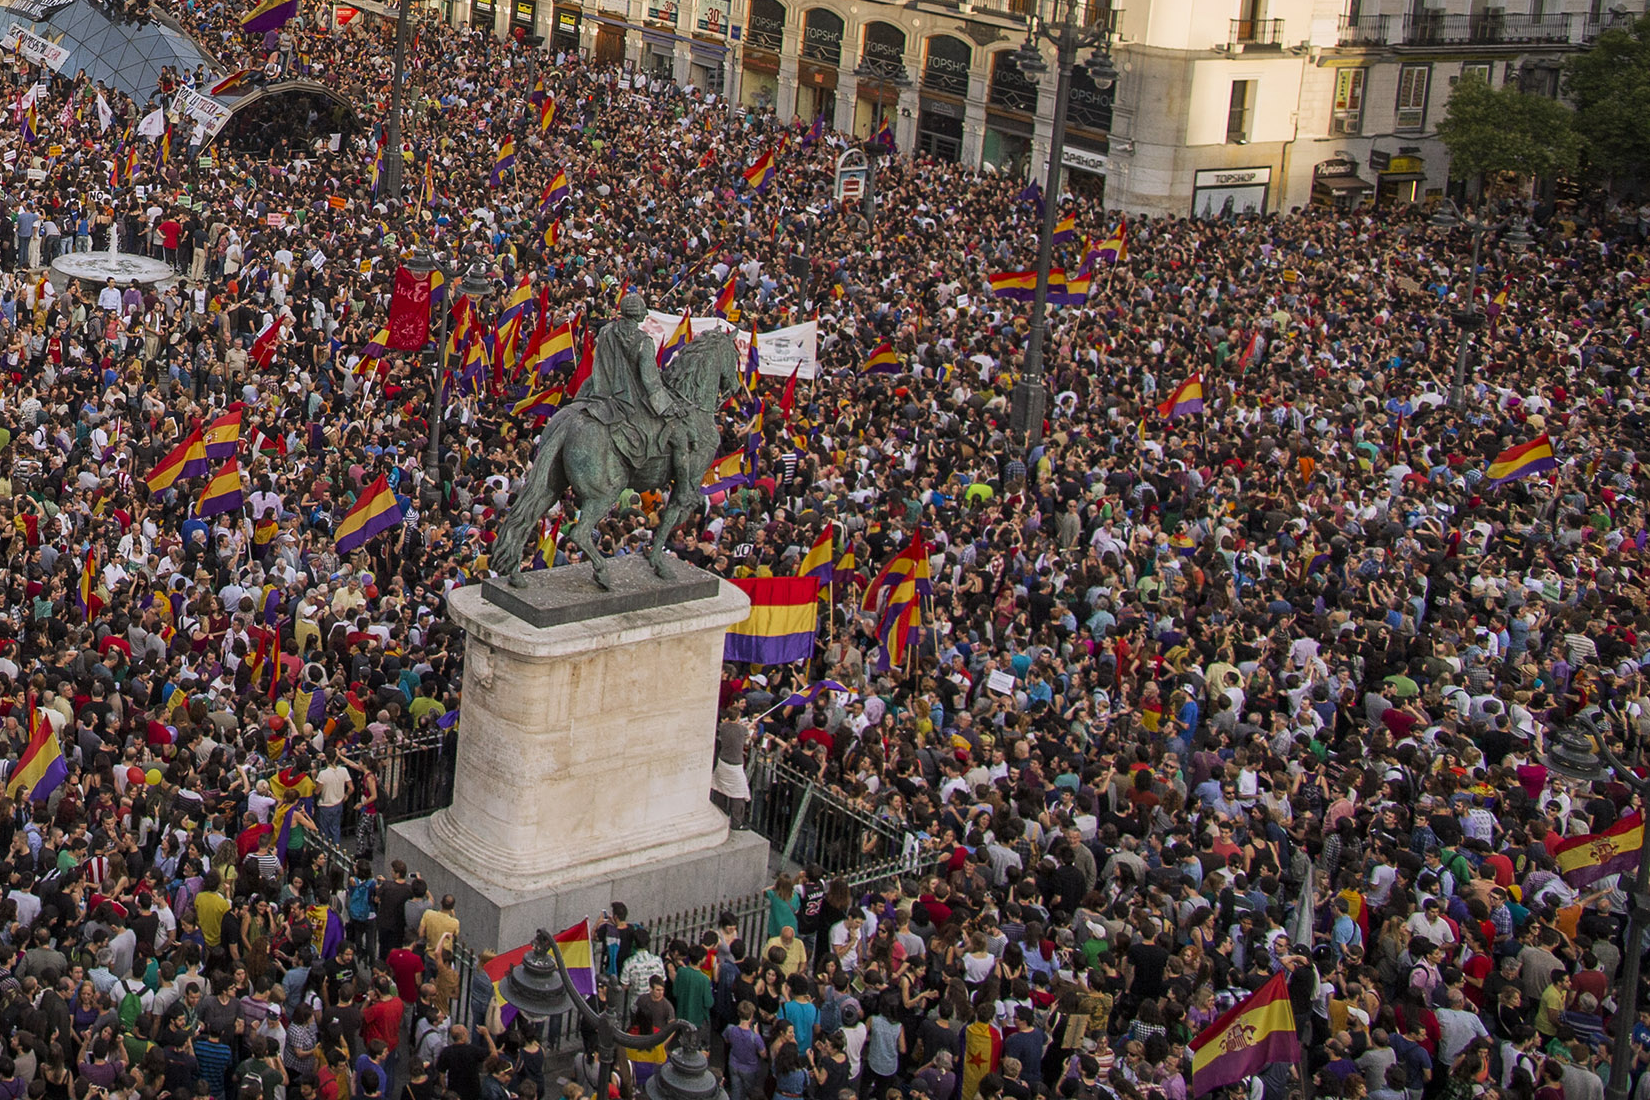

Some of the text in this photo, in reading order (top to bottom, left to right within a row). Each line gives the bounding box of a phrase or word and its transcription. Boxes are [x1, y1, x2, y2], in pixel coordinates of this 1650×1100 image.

[751, 15, 781, 31] TOPSHO
[805, 27, 841, 43] TOPSHO
[867, 40, 900, 56] TOPSHO
[928, 55, 967, 74] TOPSHO
[1062, 151, 1103, 169] OPSHOP
[1214, 173, 1256, 185] TOPSHOP
[90, 191, 103, 202] NO
[735, 545, 750, 556] NO
